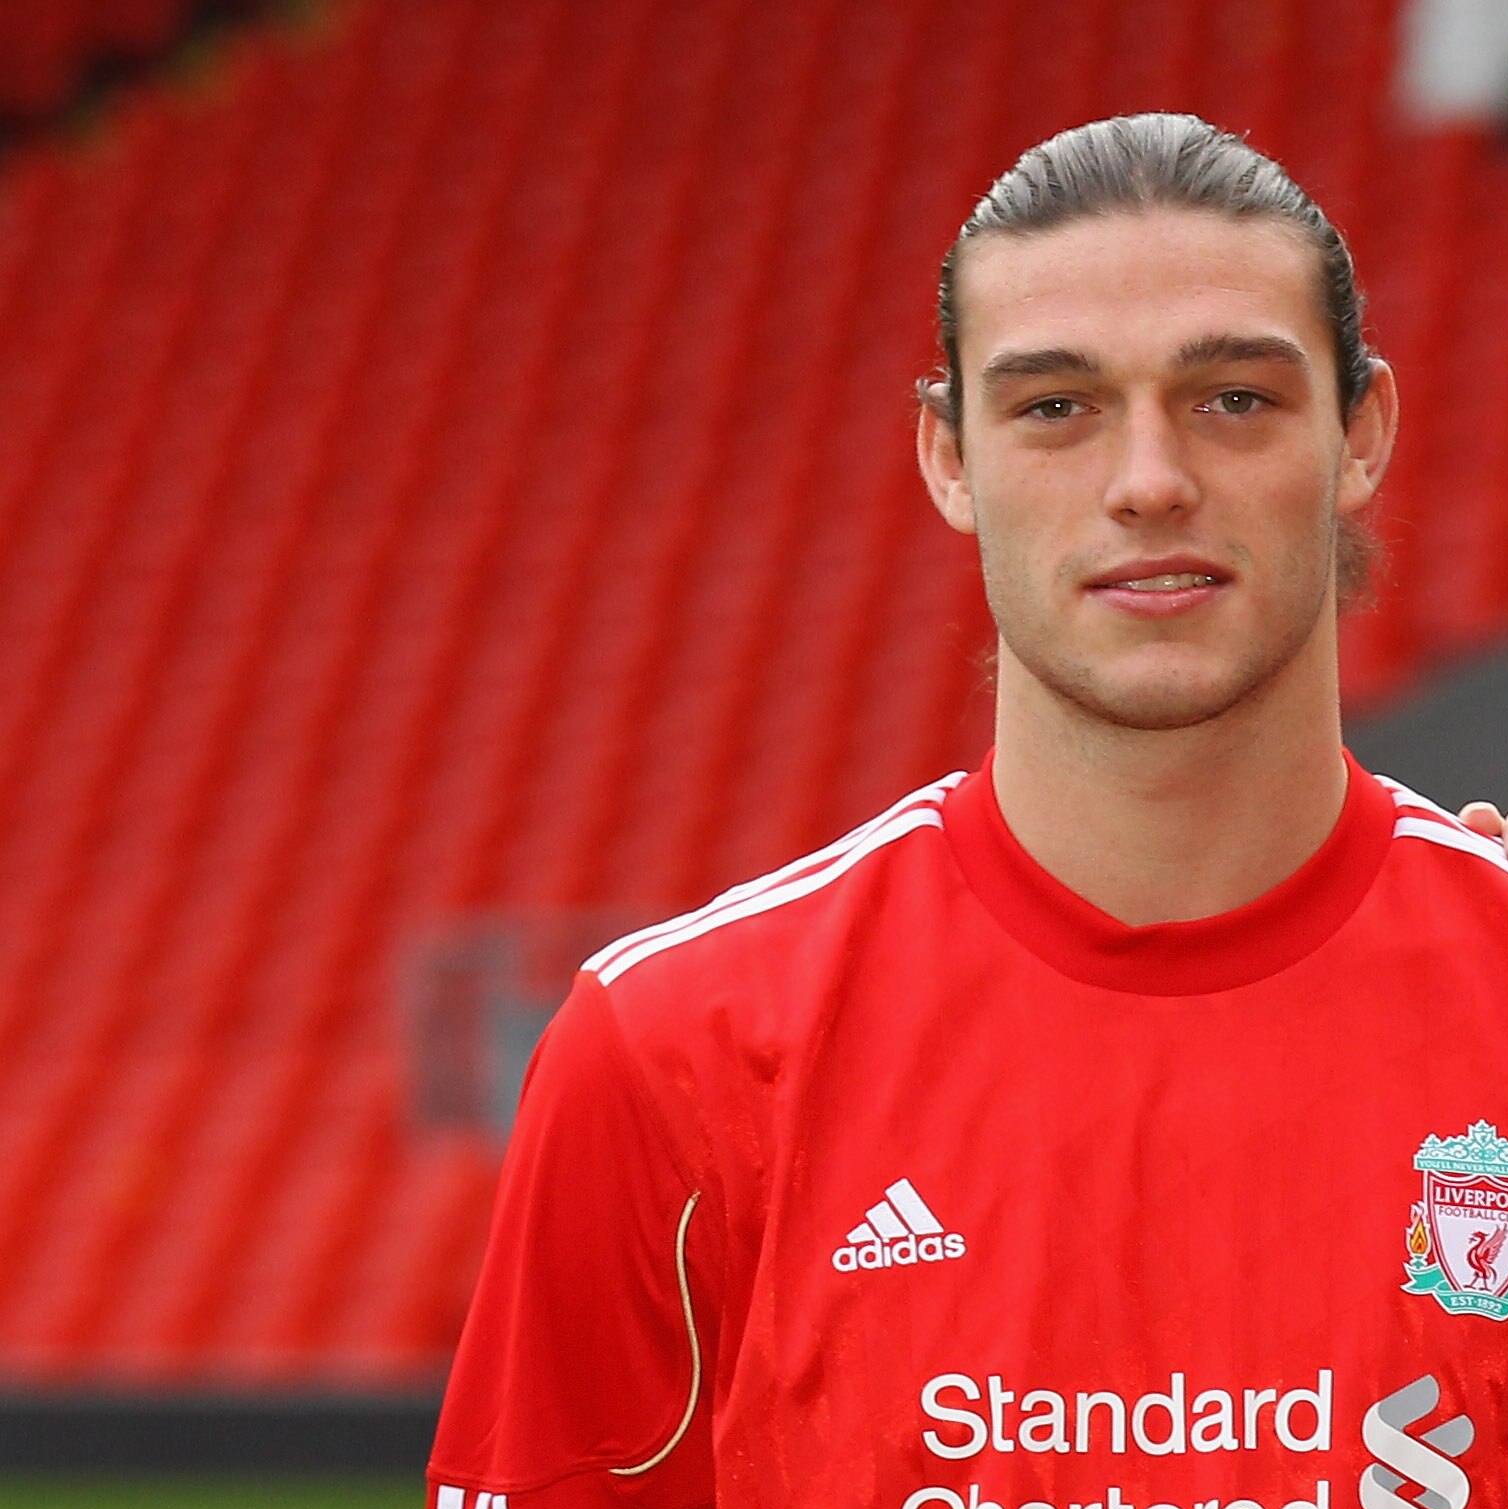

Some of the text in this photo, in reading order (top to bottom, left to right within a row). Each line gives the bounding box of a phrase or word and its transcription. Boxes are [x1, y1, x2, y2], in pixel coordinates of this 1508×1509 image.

[1452, 1161, 1485, 1173] NEVER
[1438, 1206, 1497, 1221] FOOTBALL
[831, 1233, 967, 1272] adidas
[919, 1370, 1332, 1460] Standard
